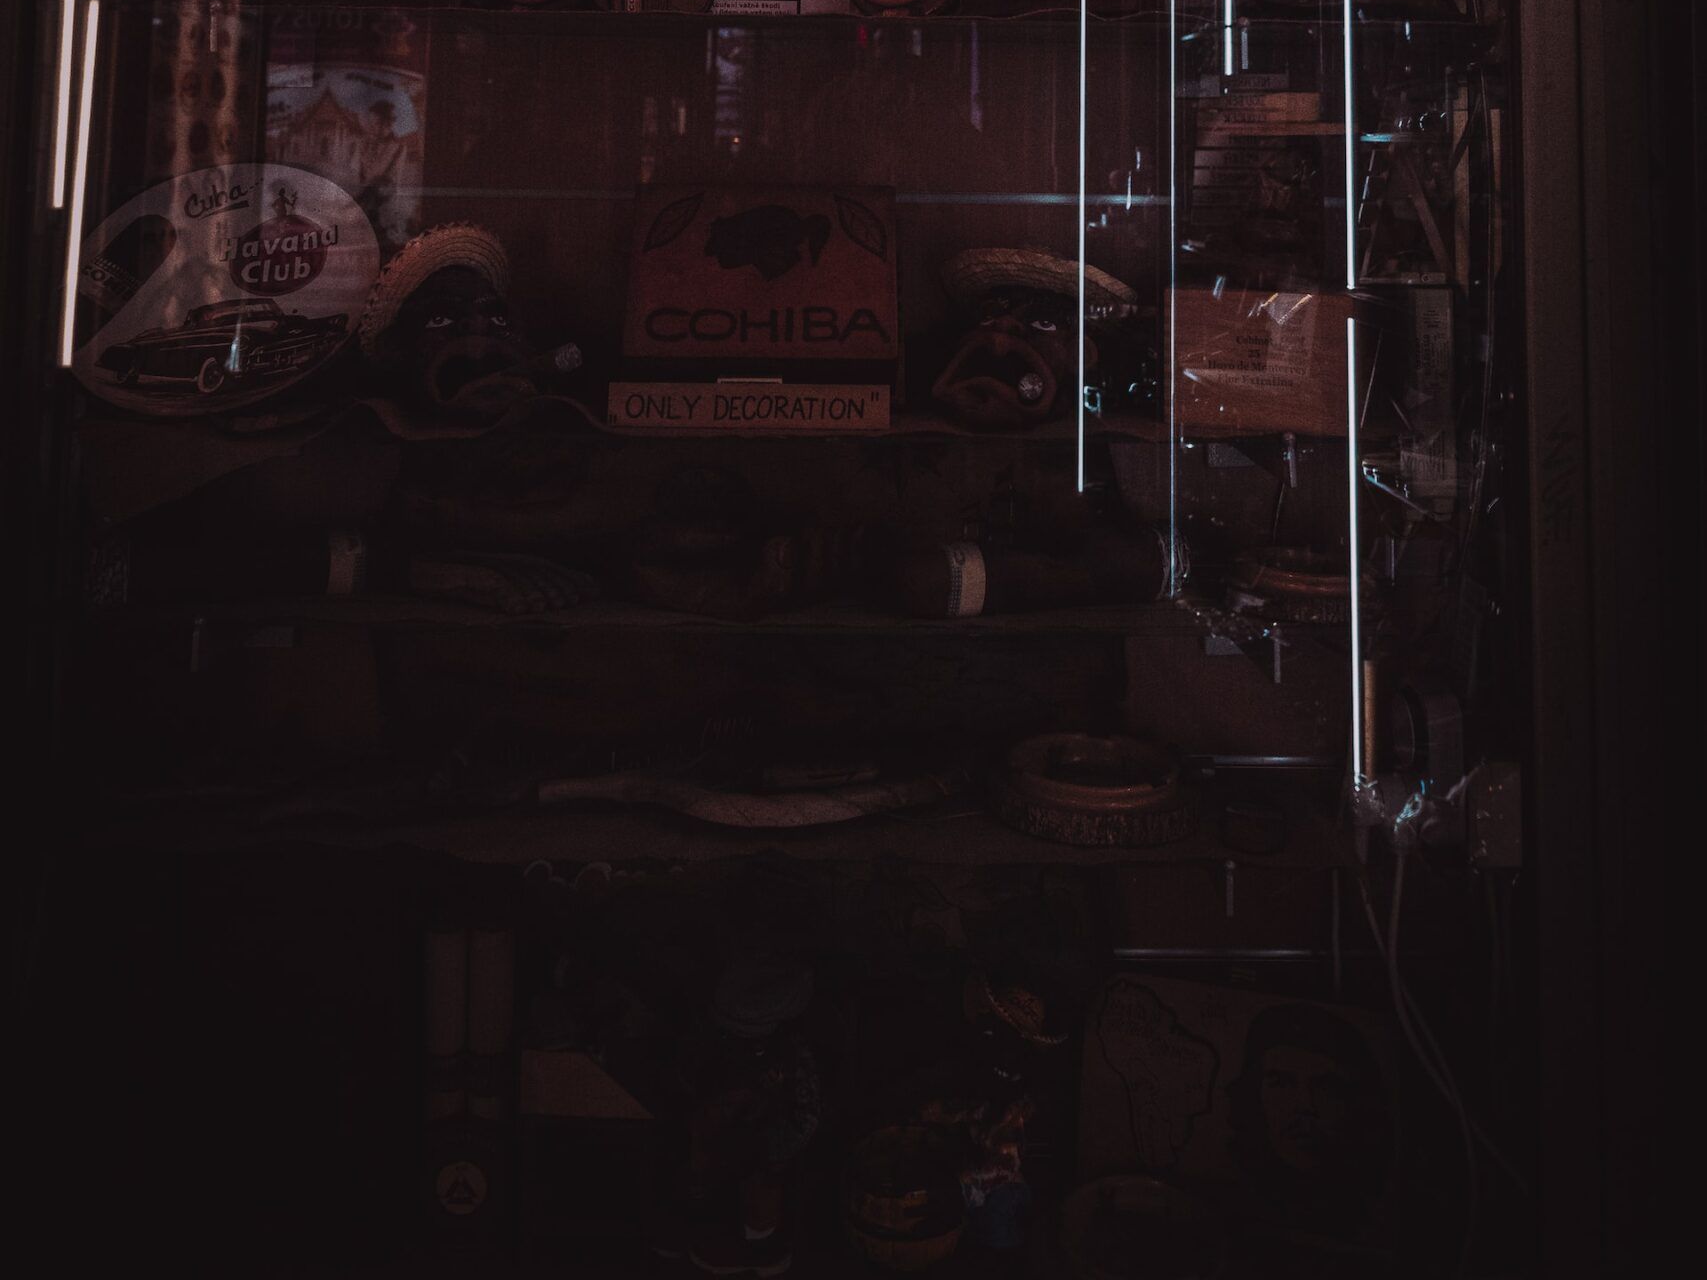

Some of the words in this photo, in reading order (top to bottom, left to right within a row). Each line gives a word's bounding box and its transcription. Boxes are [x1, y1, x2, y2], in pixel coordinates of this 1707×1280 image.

[184, 184, 249, 219] Cuba
[240, 255, 312, 284] Club
[645, 306, 891, 344] COHIBA
